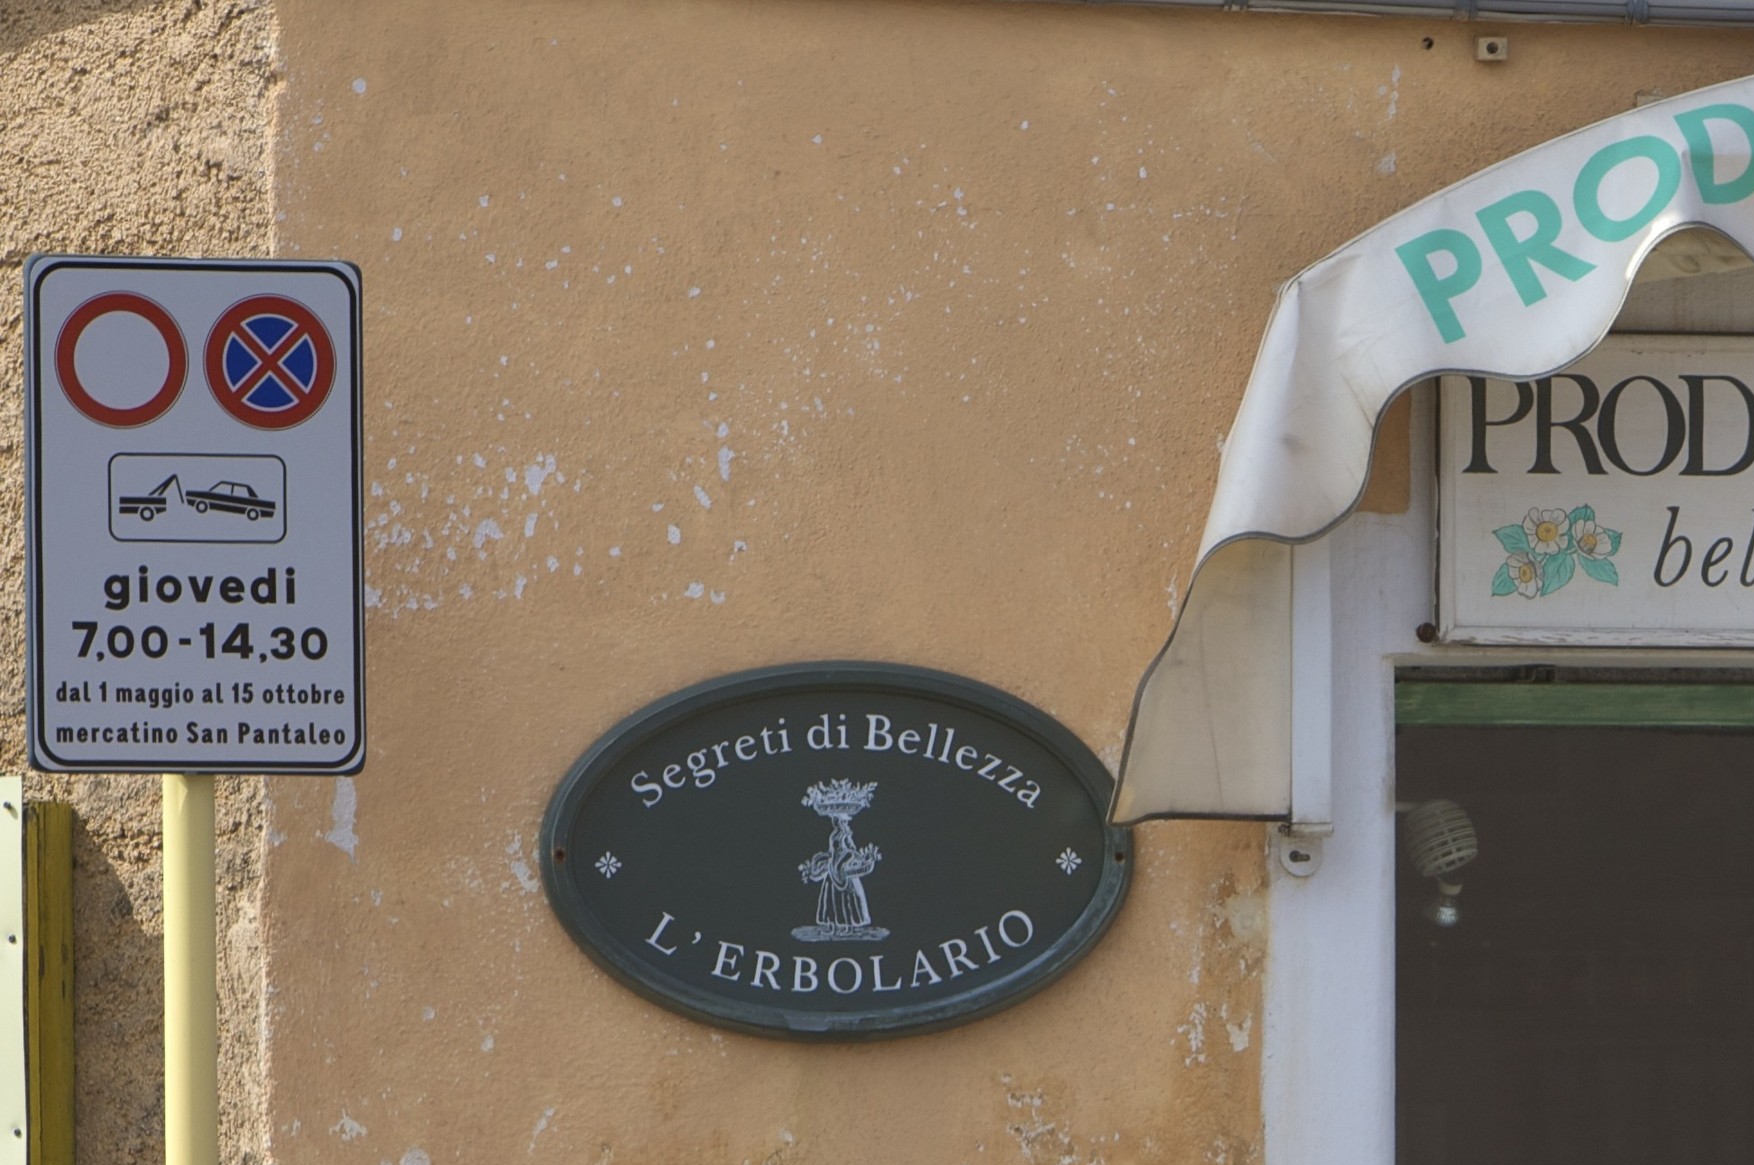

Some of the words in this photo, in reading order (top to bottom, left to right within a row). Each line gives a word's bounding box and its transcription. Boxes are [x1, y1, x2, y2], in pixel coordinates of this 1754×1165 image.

[103, 565, 296, 610] giovedi
[56, 681, 91, 703] dal
[99, 682, 108, 702] 1
[115, 683, 194, 709] maggio
[201, 683, 224, 704] al
[231, 684, 254, 705] 15
[262, 683, 345, 706] ottobre
[56, 722, 178, 745] mercatino
[186, 722, 228, 744] San
[238, 722, 346, 746] Pantaleo
[630, 718, 793, 808] Segreti
[806, 714, 849, 750] di
[864, 714, 1043, 808] Bellezza
[644, 910, 1035, 994] L'ERBOLARIO
